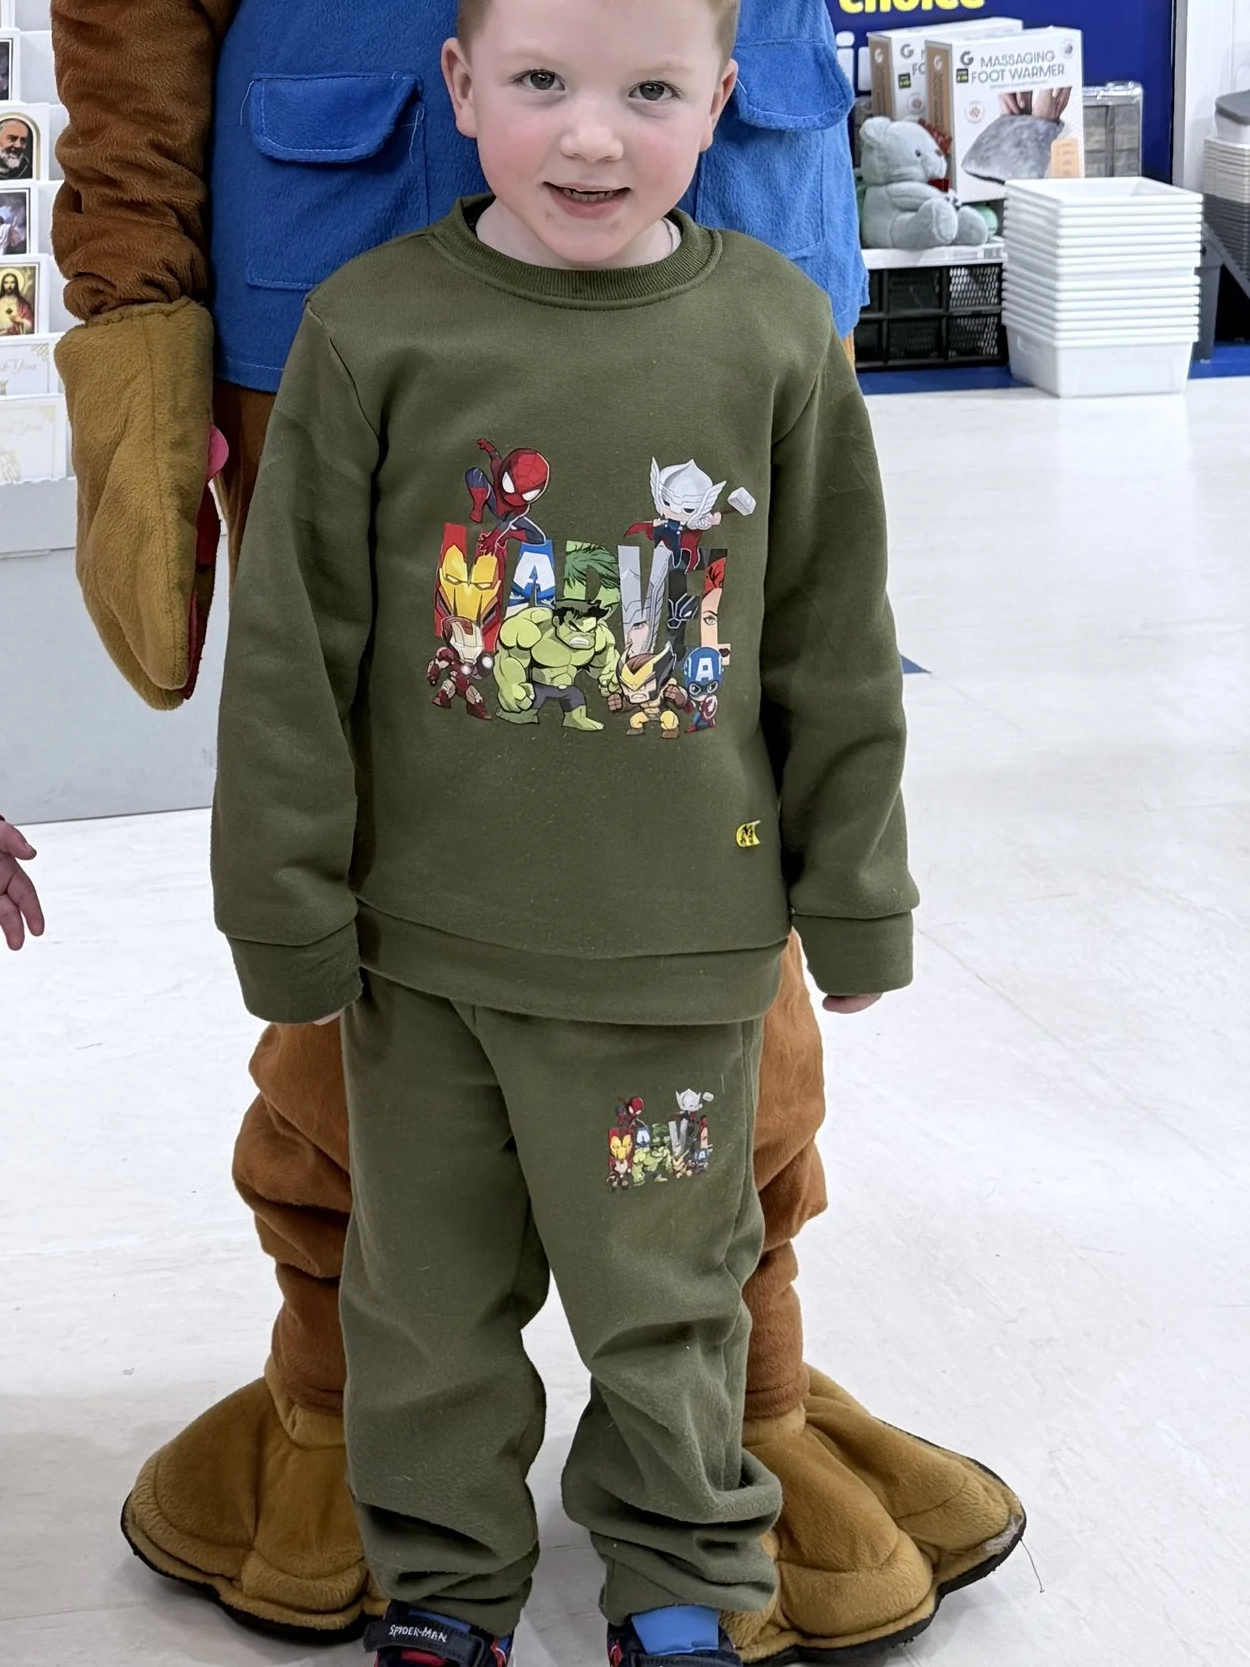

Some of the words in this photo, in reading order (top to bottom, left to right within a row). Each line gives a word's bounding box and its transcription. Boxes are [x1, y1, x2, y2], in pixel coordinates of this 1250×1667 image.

[980, 50, 1056, 69] MASSAGING
[971, 69, 1006, 84] FOOT
[1008, 63, 1065, 80] WARMER
[10, 357, 37, 375] You
[388, 1623, 448, 1644] SPIDER-MAN
